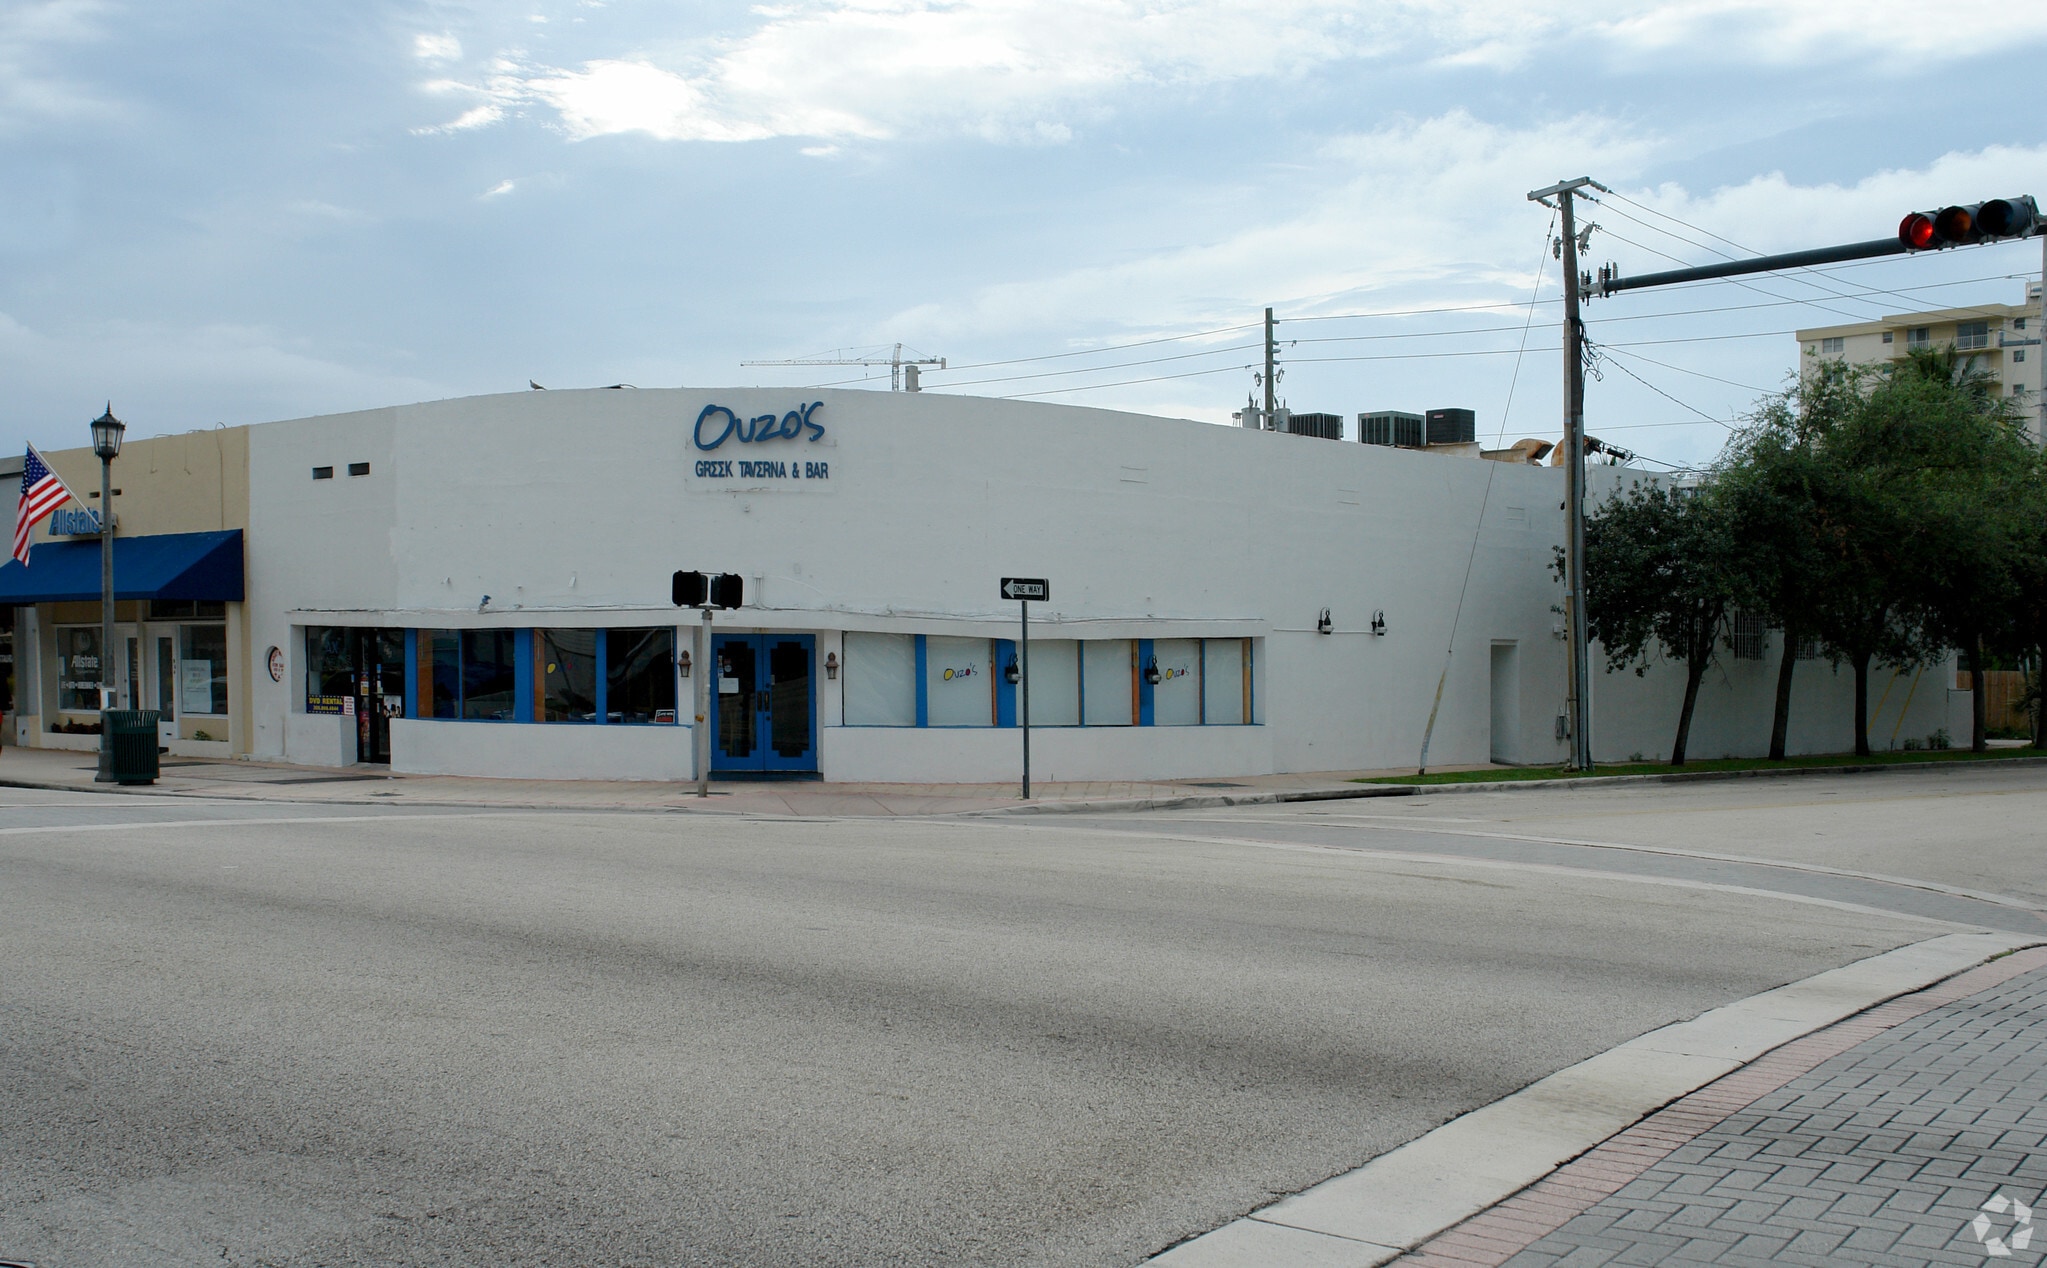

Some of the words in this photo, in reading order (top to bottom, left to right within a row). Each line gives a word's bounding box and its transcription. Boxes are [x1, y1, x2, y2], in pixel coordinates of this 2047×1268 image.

[792, 462, 800, 479] &
[806, 462, 829, 479] BAR
[48, 507, 101, 536] Allstate
[1013, 585, 1026, 594] ONE
[1028, 585, 1042, 594] WAY
[71, 655, 99, 668] Allstate
[309, 697, 321, 705] DVD
[322, 697, 343, 706] RENTAL
